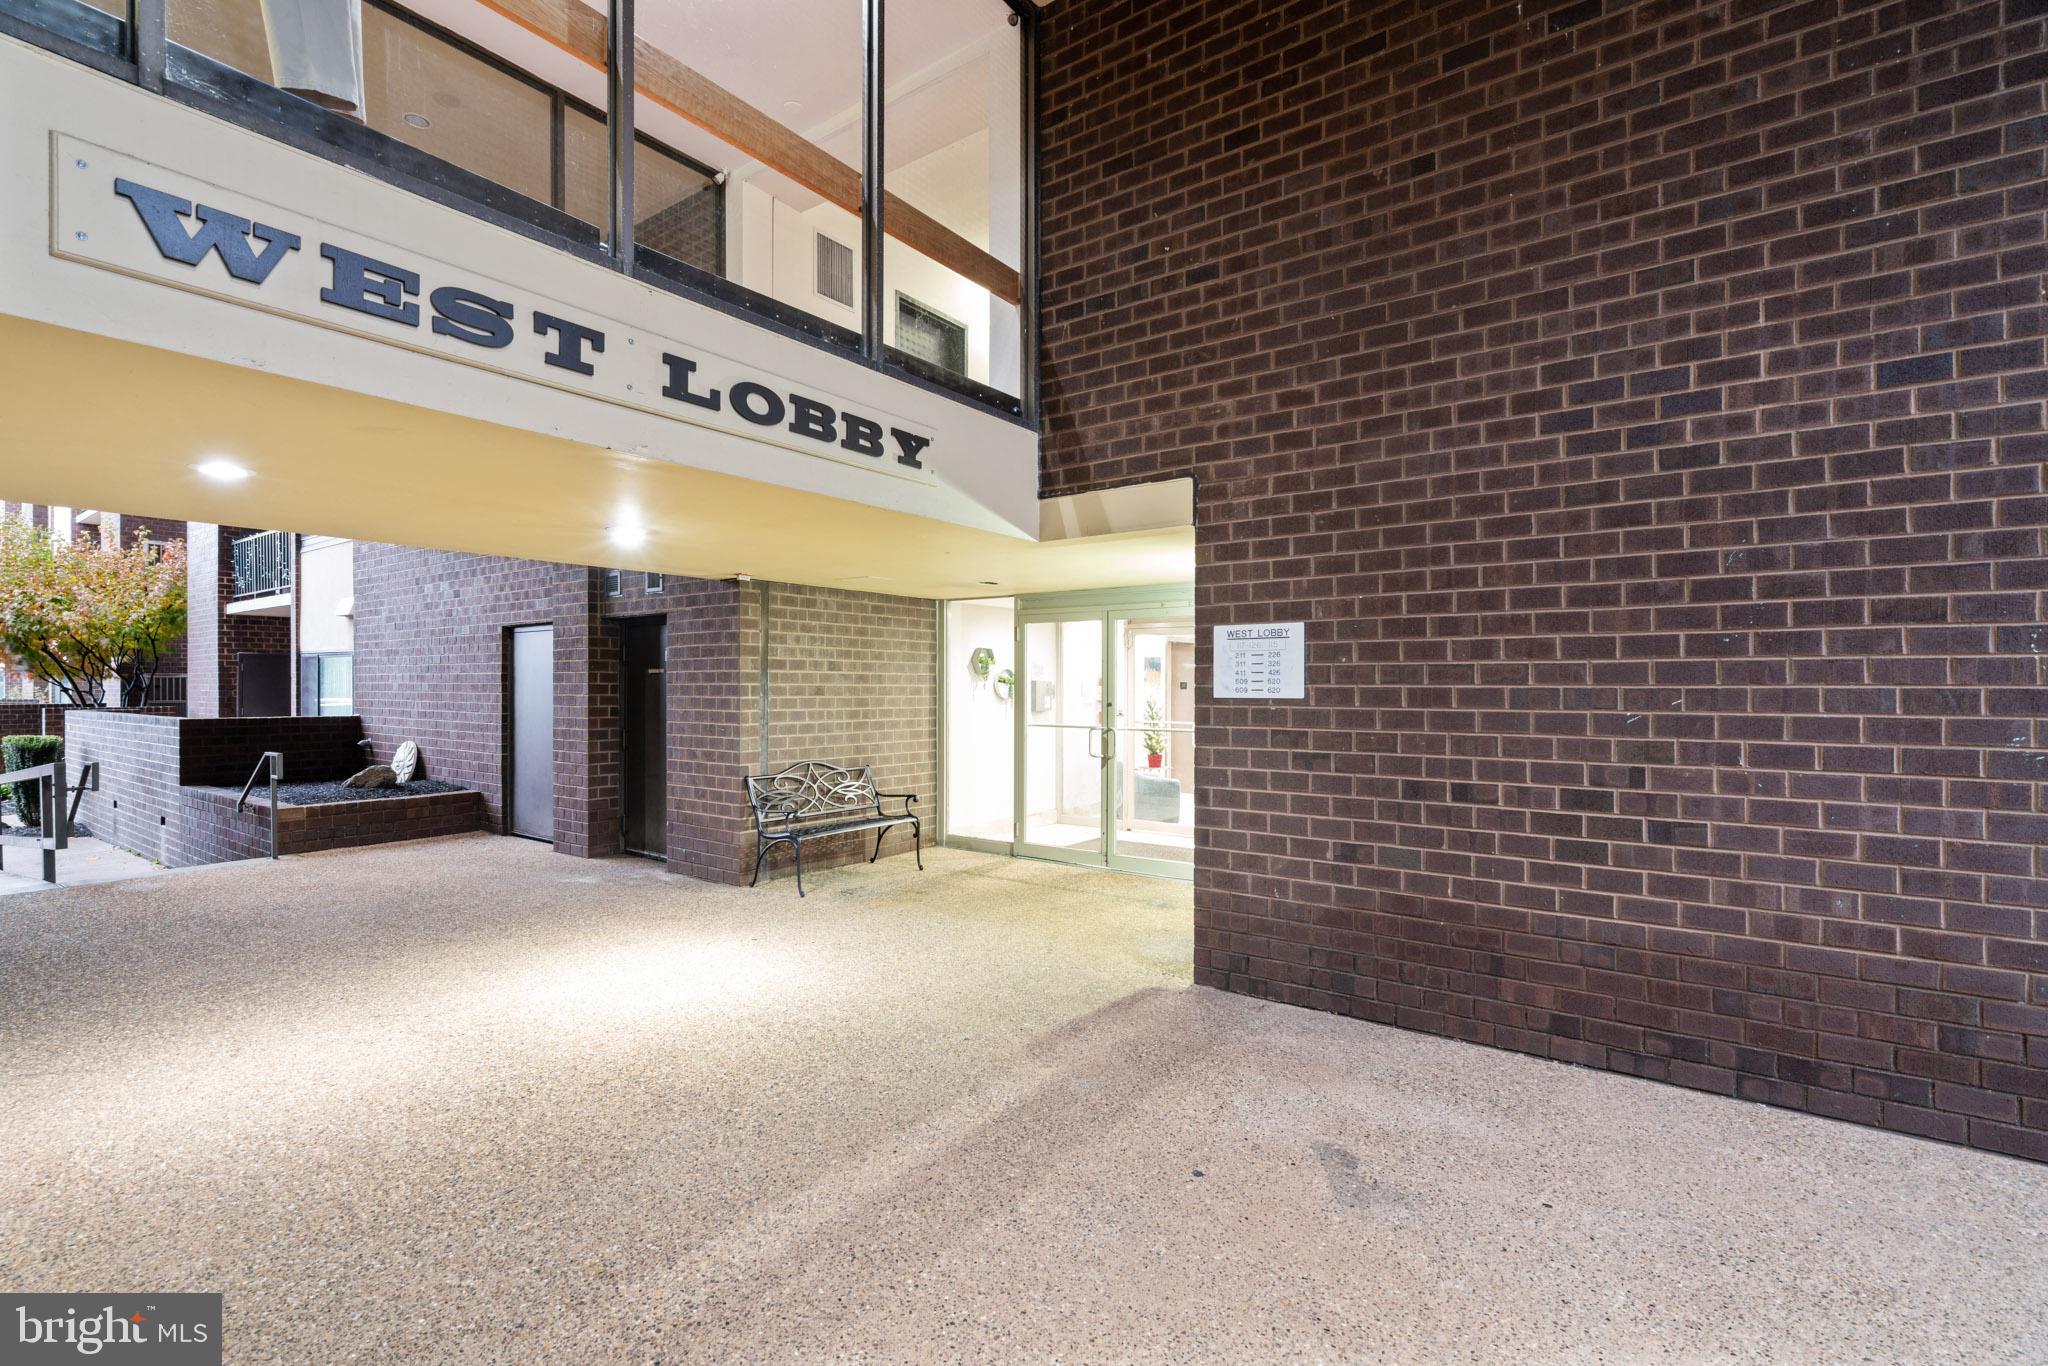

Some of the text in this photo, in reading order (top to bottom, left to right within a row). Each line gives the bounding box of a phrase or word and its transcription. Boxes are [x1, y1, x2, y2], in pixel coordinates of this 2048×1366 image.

[114, 177, 930, 469] WEST LOBBY
[1226, 628, 1290, 638] WEST LOBBY
